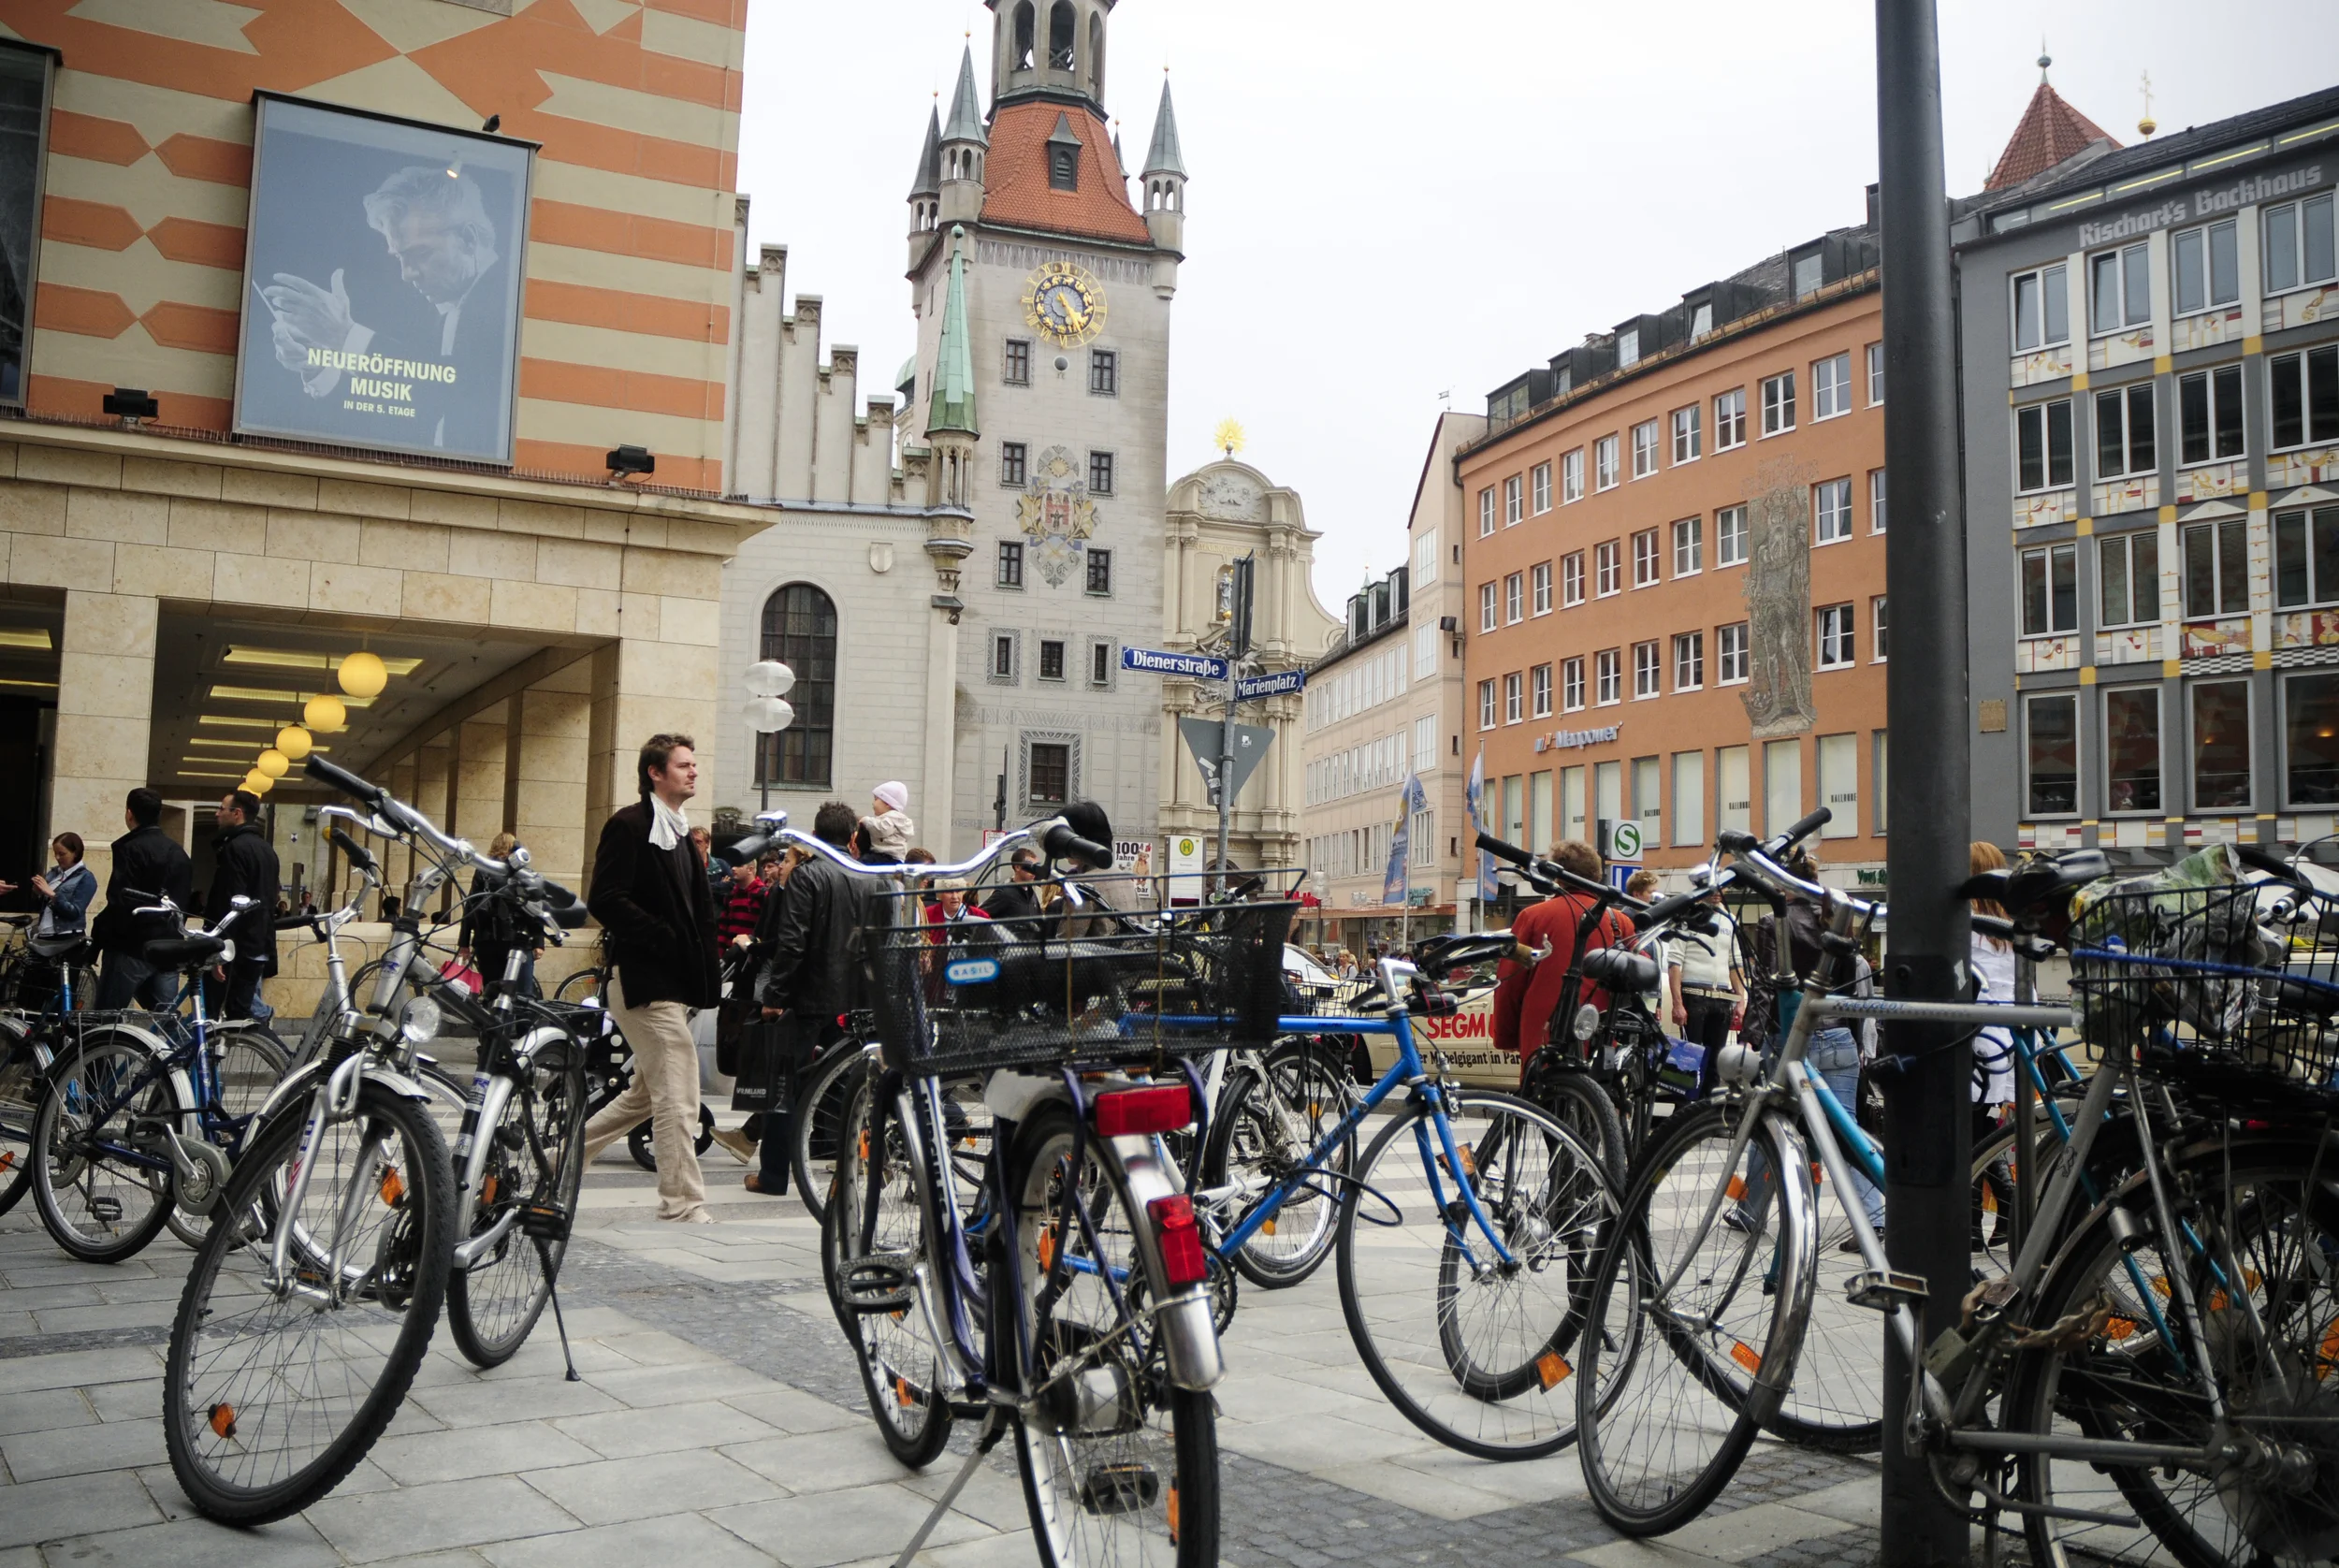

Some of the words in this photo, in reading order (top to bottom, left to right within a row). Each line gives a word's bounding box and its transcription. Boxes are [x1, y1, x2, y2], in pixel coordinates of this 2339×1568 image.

[2079, 200, 2186, 248] Rischart's
[2195, 165, 2322, 216] Backhaus
[308, 348, 457, 384] NEUERÖFFNUNG
[351, 377, 412, 401] MUSIK
[343, 400, 354, 410] IN
[356, 401, 374, 413] DER
[376, 404, 385, 414] 5.
[388, 405, 415, 417] ETAGE
[1133, 650, 1220, 675] Dienerstraße
[1237, 675, 1297, 699] Marienplatz
[1115, 842, 1140, 855] 100
[1617, 824, 1639, 856] S
[1431, 1051, 1489, 1067] Mbelgigant
[1490, 1051, 1502, 1065] in
